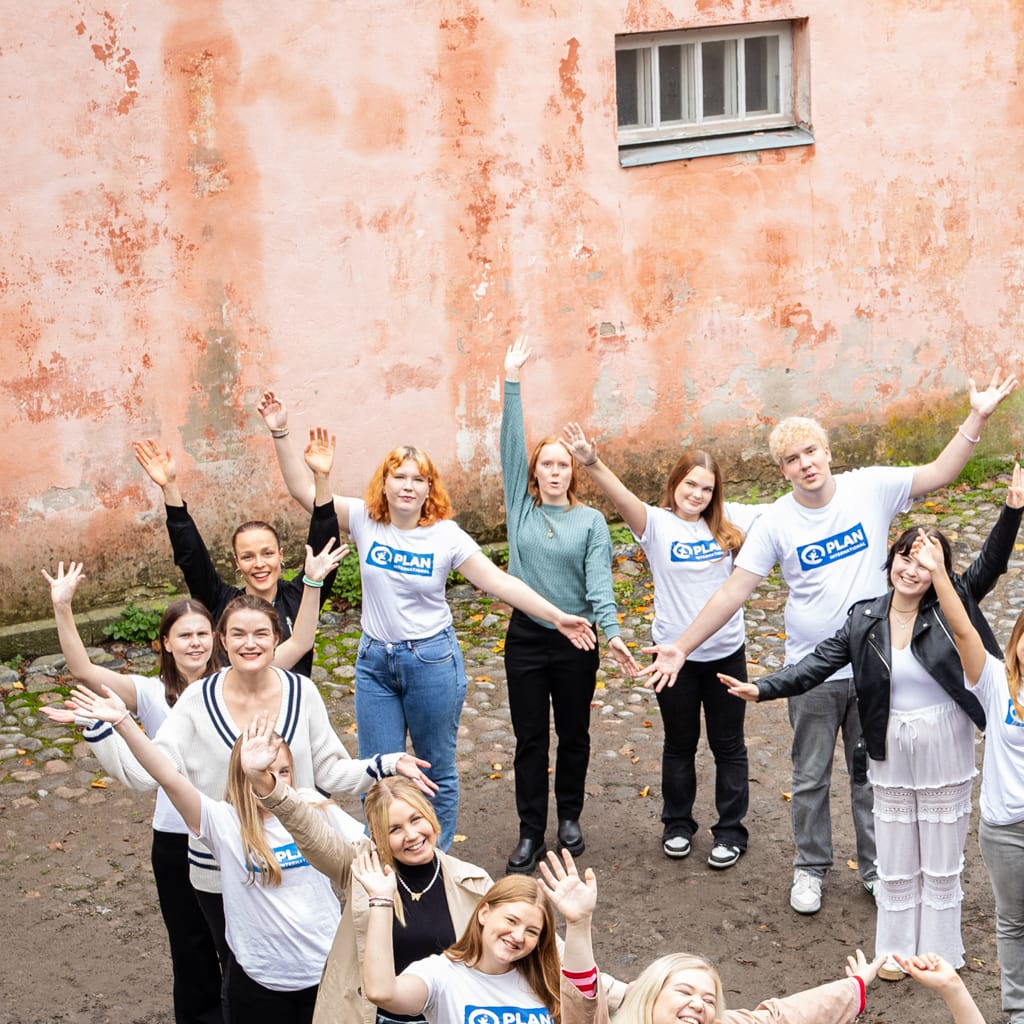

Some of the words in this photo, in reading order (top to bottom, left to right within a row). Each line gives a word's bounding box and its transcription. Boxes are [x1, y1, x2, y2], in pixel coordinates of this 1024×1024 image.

[826, 529, 864, 554] PLAN
[693, 543, 722, 556] PLA
[393, 553, 431, 569] PLAN
[276, 849, 303, 863] PL
